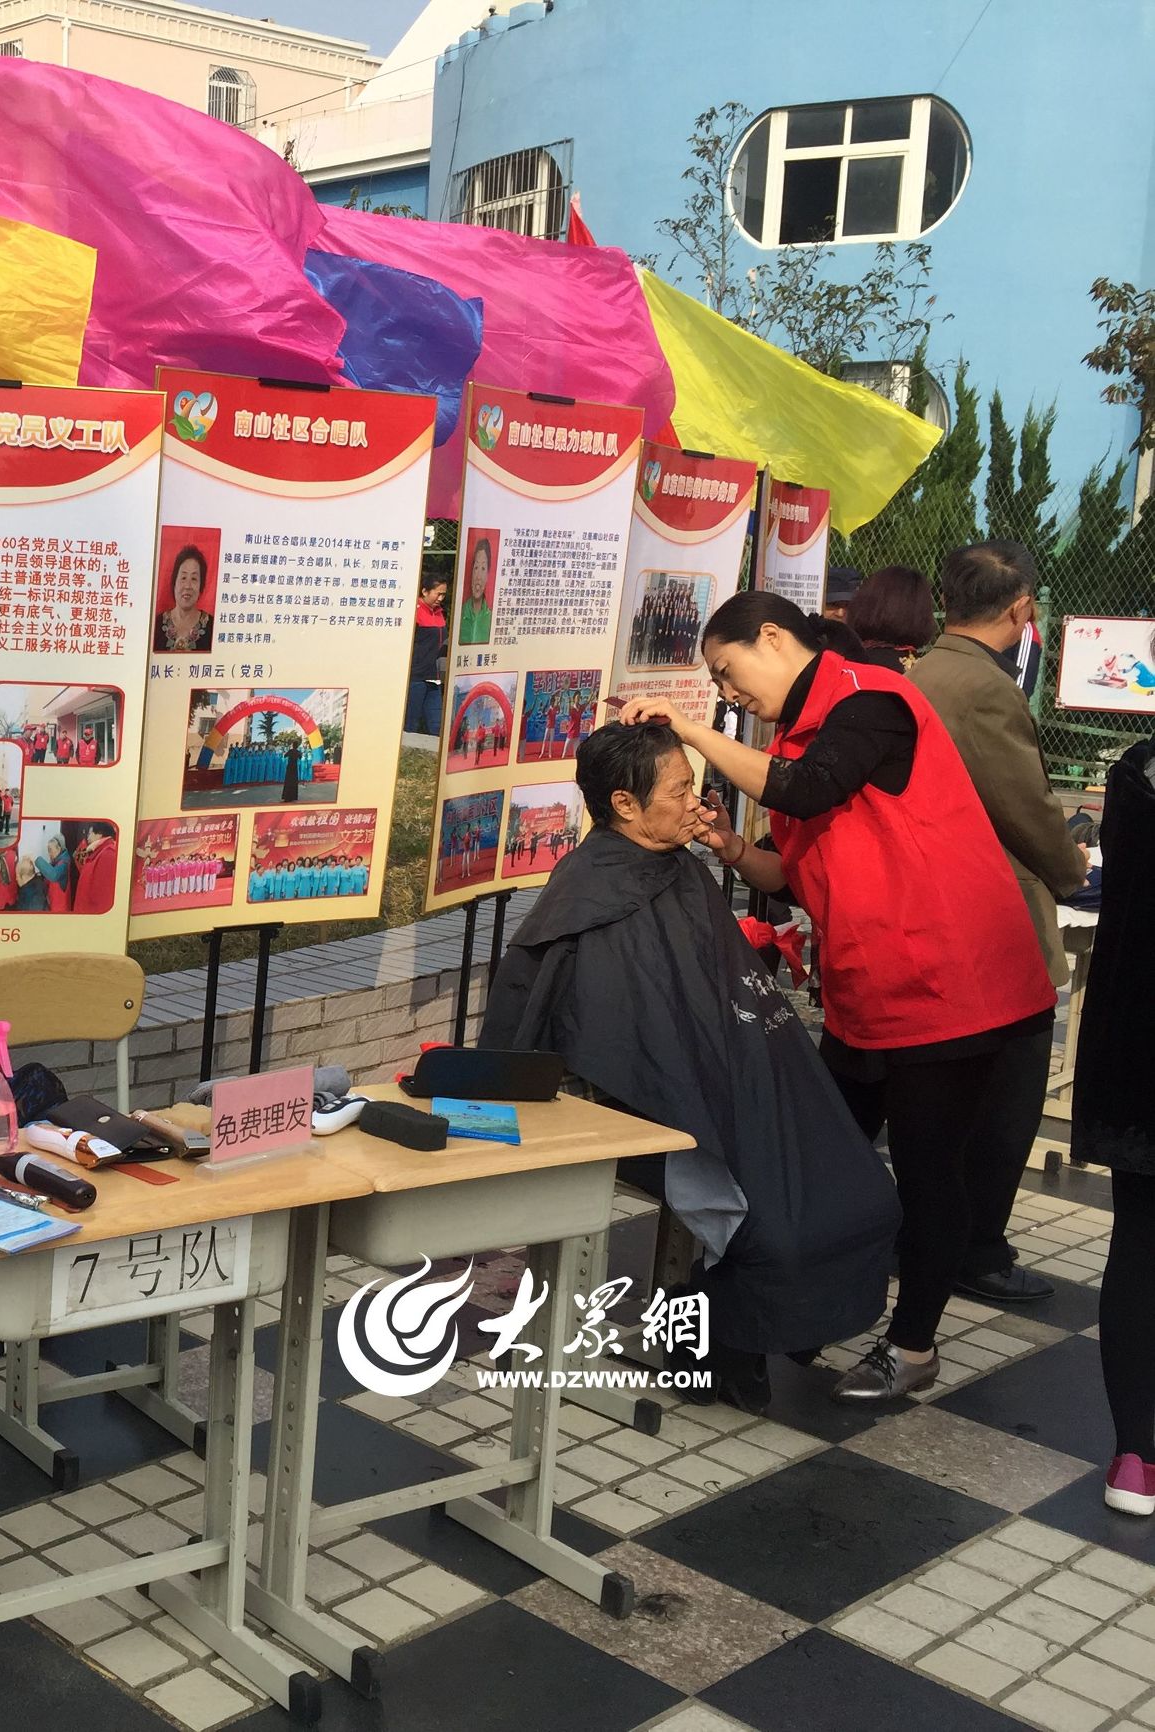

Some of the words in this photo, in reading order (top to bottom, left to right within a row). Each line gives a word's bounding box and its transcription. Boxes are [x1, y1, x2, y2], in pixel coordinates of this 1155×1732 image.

[233, 410, 368, 448] 南山社区合唱队
[215, 1097, 309, 1149] 免费理发
[70, 1226, 229, 1304] 7号队
